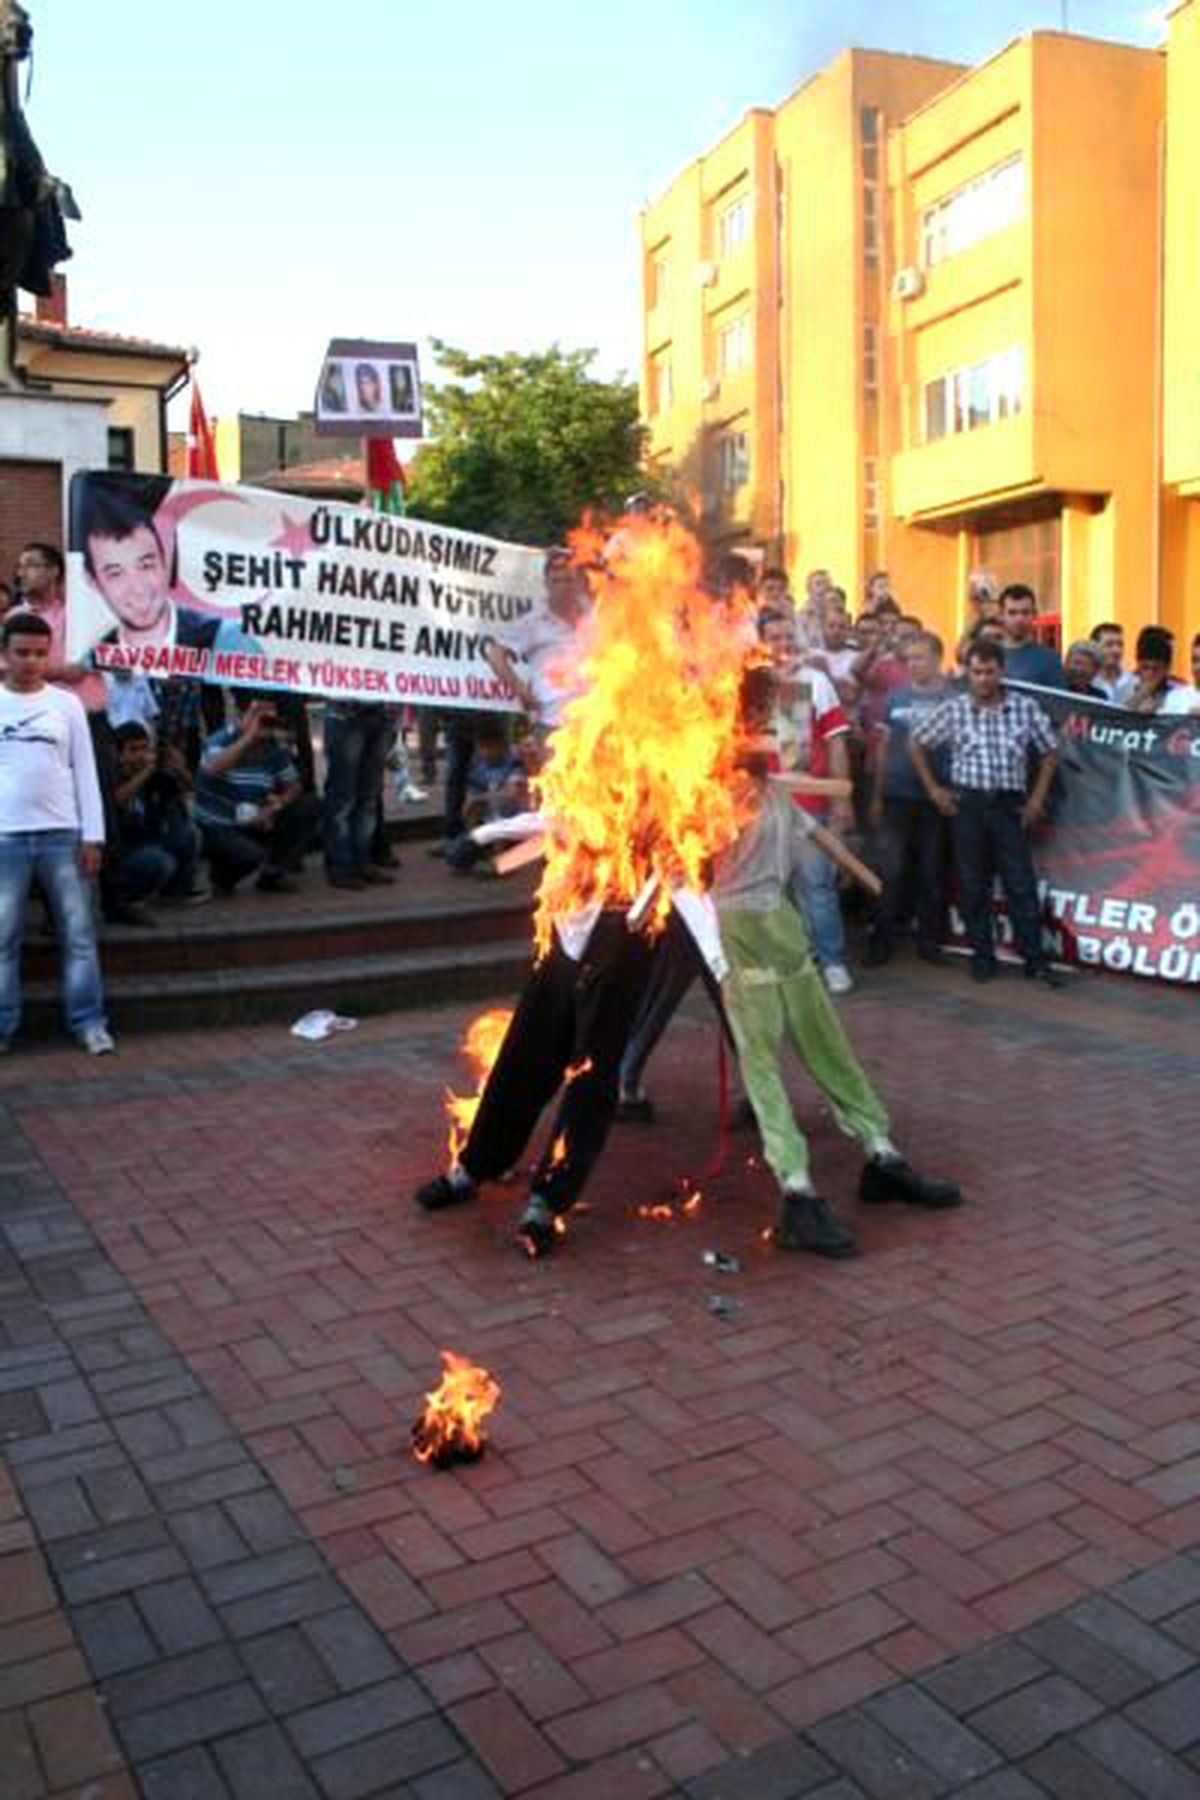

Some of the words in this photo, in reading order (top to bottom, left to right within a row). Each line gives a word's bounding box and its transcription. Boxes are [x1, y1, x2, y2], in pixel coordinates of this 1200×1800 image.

[310, 506, 499, 577] ÜLKÜDAŞIMIZ
[203, 550, 306, 592] ŞEHİT
[317, 561, 419, 607] HAKAN
[240, 603, 406, 655] RAHMETLE
[215, 652, 301, 686] MESLEK
[308, 660, 389, 692] YÜKSEK
[395, 671, 460, 697] OKULU
[1064, 711, 1158, 752] Murat
